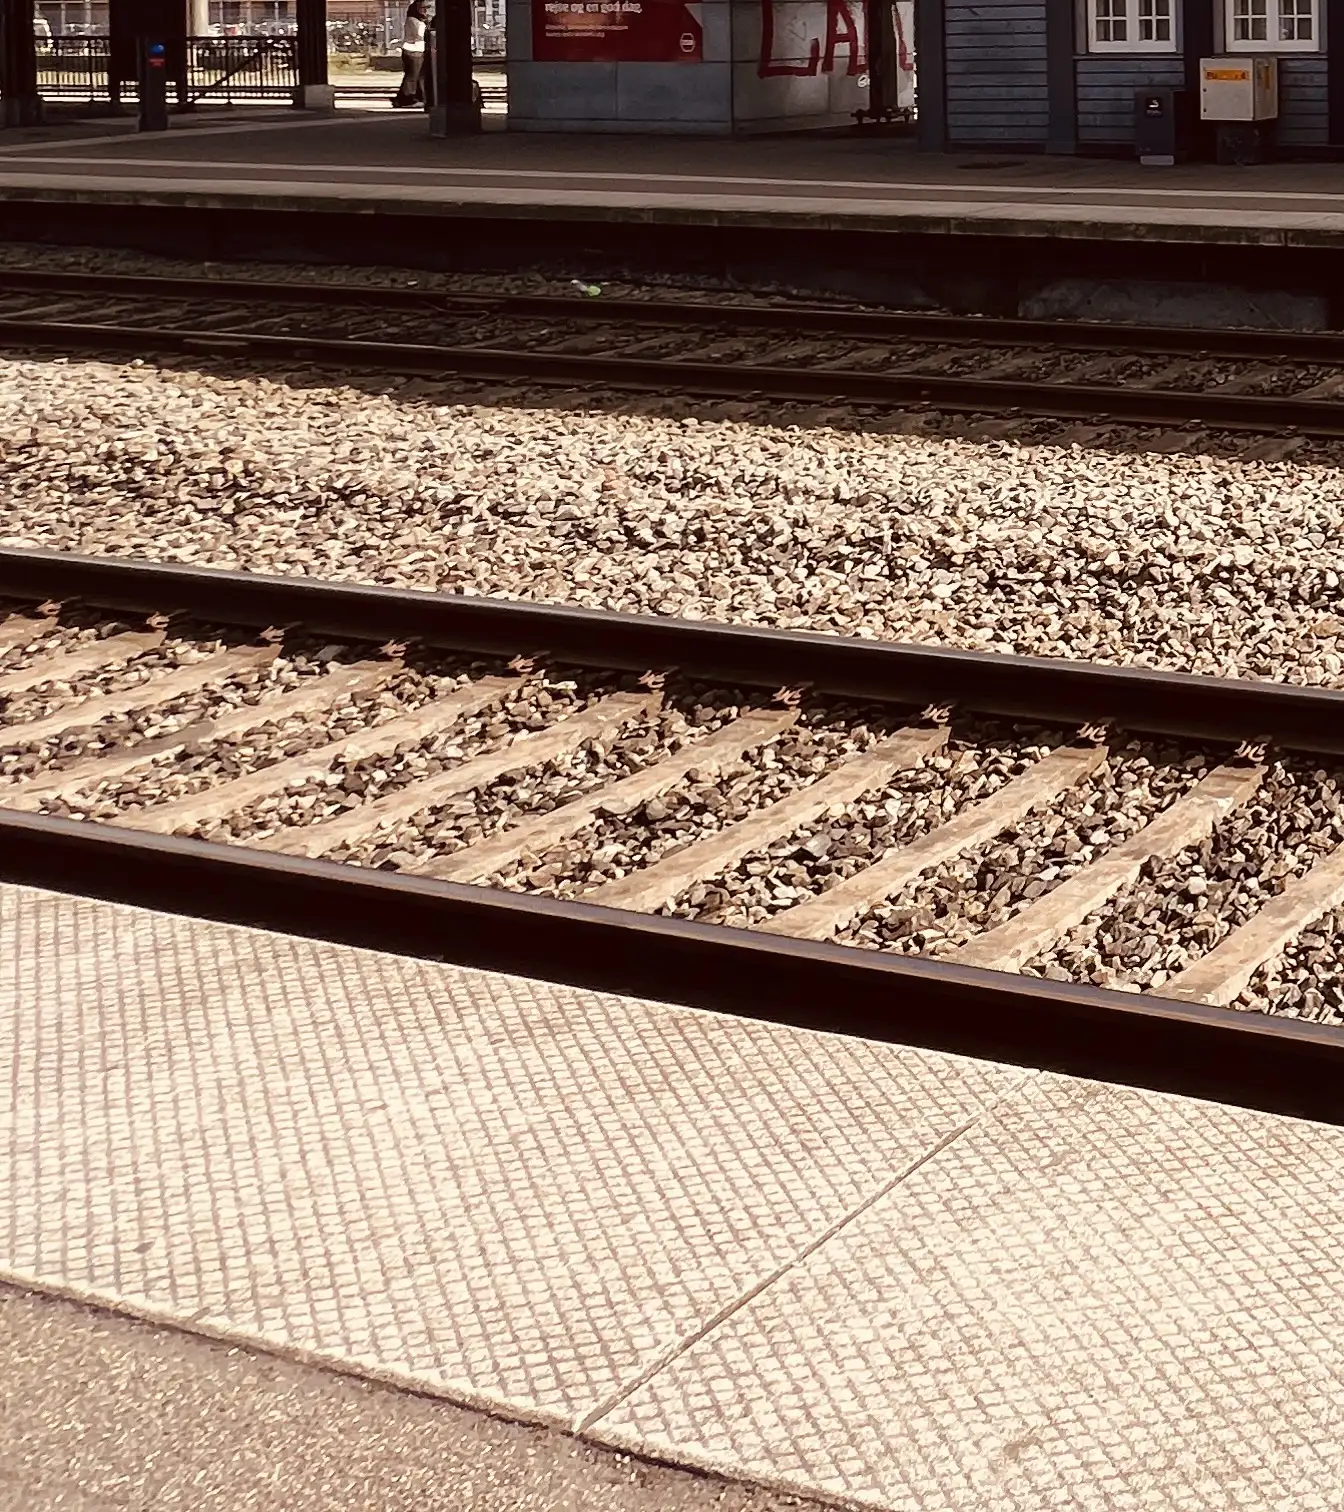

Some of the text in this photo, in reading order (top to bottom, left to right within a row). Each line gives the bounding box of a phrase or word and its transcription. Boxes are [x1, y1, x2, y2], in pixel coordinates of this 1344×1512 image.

[570, 3, 585, 13] og
[586, 3, 599, 13] en
[600, 1, 621, 14] god
